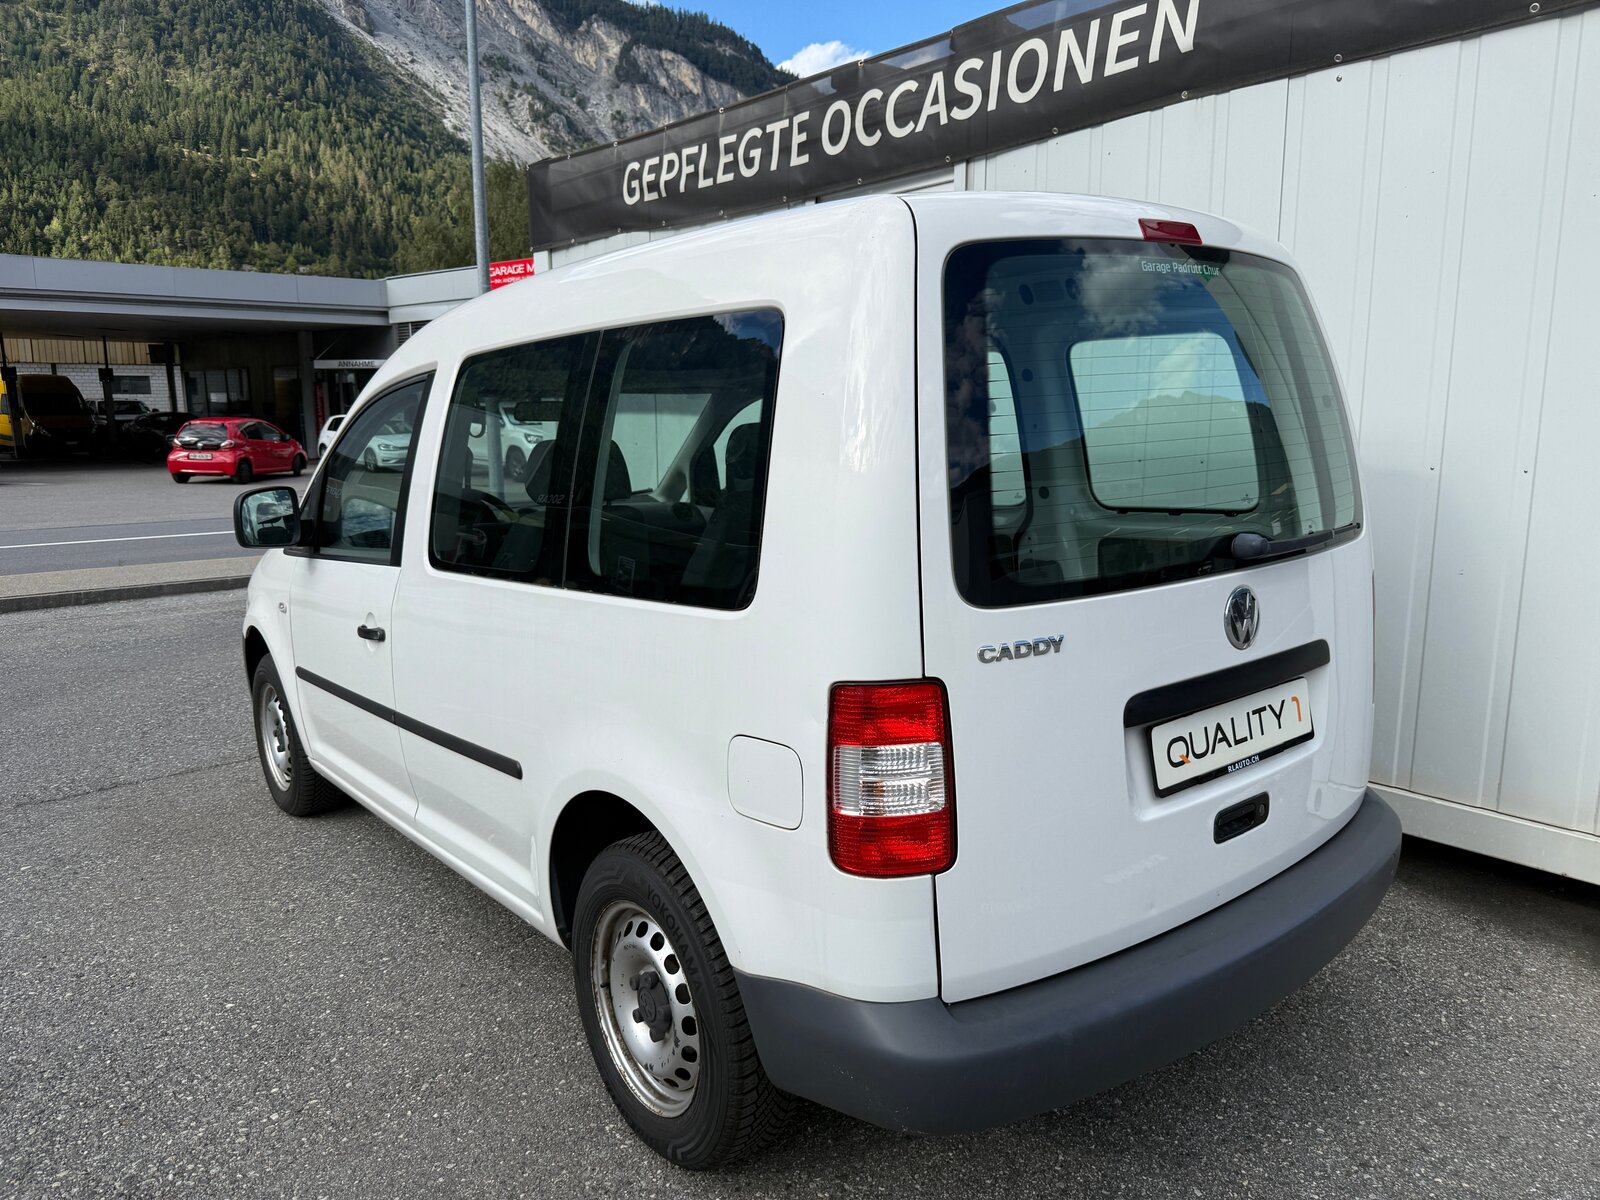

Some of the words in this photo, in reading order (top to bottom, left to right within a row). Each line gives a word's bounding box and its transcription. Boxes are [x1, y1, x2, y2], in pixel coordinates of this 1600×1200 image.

[622, 110, 810, 206] GEPFLEGTE
[821, 0, 1200, 156] OCCASIONEN
[489, 264, 525, 277] GARAGE
[1141, 261, 1171, 274] Garage
[1203, 264, 1220, 276] Chur
[338, 360, 376, 368] ANNAHME
[976, 634, 1065, 664] CADDY
[1166, 699, 1286, 769] QUALITY
[1291, 695, 1302, 722] 1
[1227, 754, 1260, 773] RLAUTO.CH
[645, 883, 705, 993] YOKOHAMA
